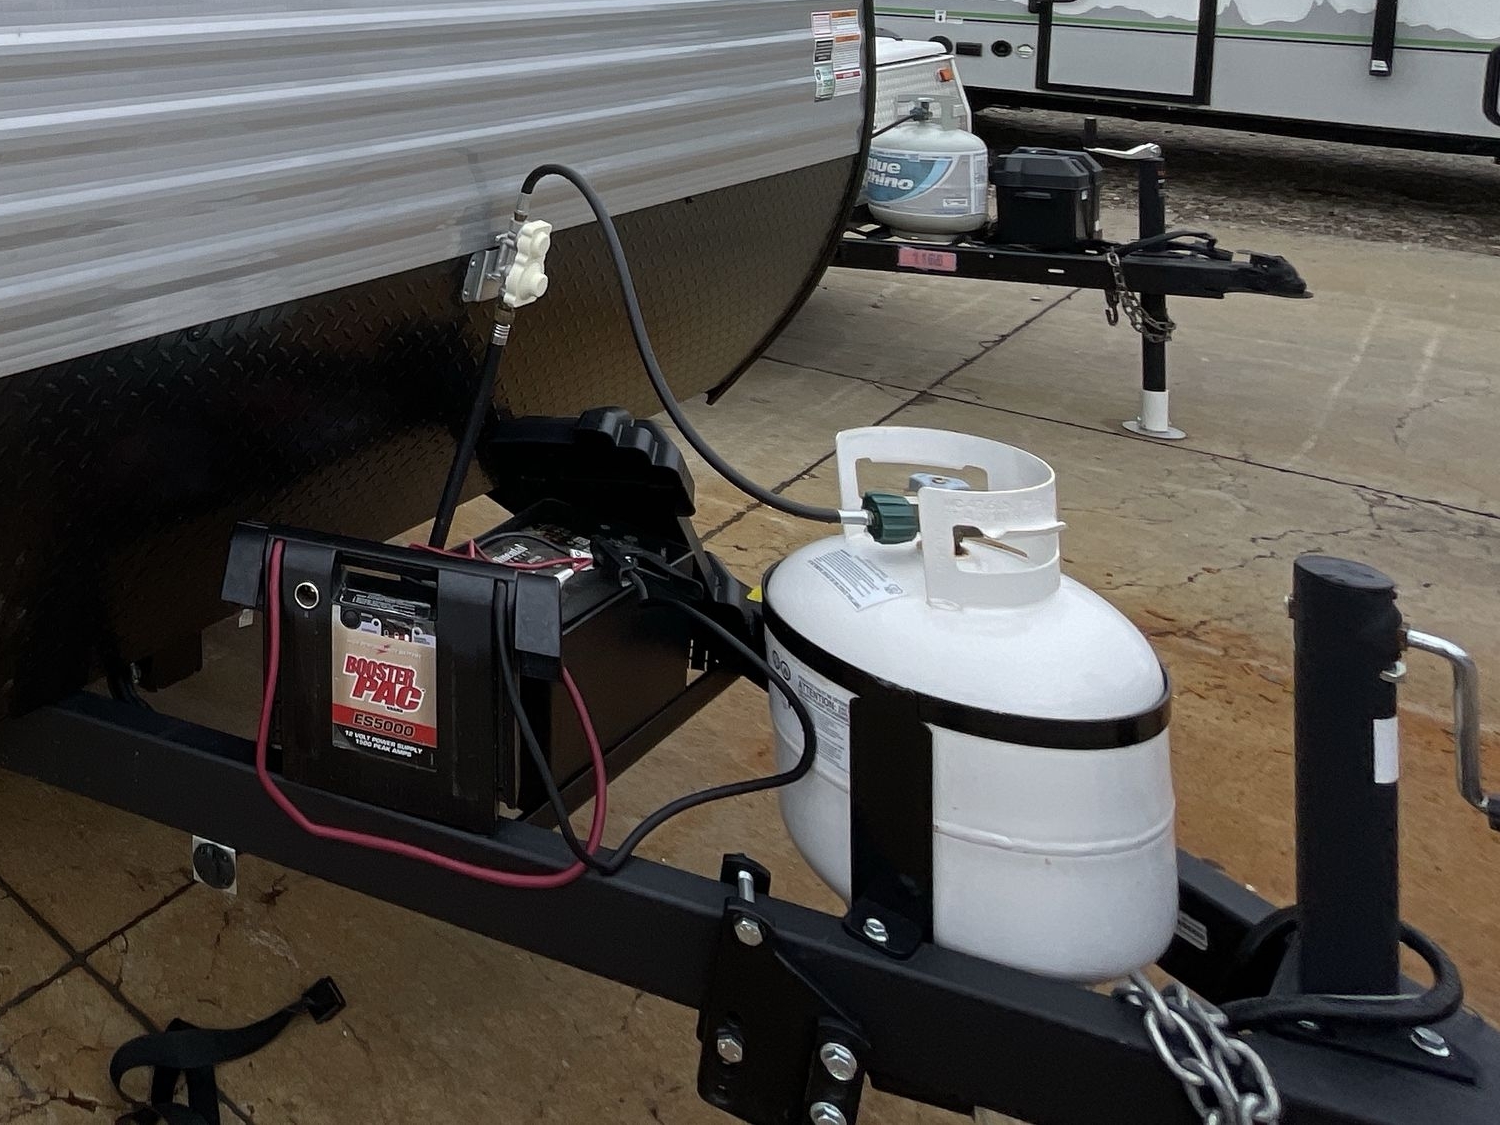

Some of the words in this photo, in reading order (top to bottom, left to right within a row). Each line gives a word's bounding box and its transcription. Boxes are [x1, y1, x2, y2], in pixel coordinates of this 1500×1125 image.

[344, 654, 416, 687] BOOSTER
[351, 675, 424, 712] PAC
[354, 712, 415, 737] ES5000
[354, 732, 371, 742] VOLT
[371, 736, 396, 748] POWER
[396, 742, 424, 755] SUPPLY
[373, 743, 391, 753] PEAK
[391, 747, 412, 758] AMPS
